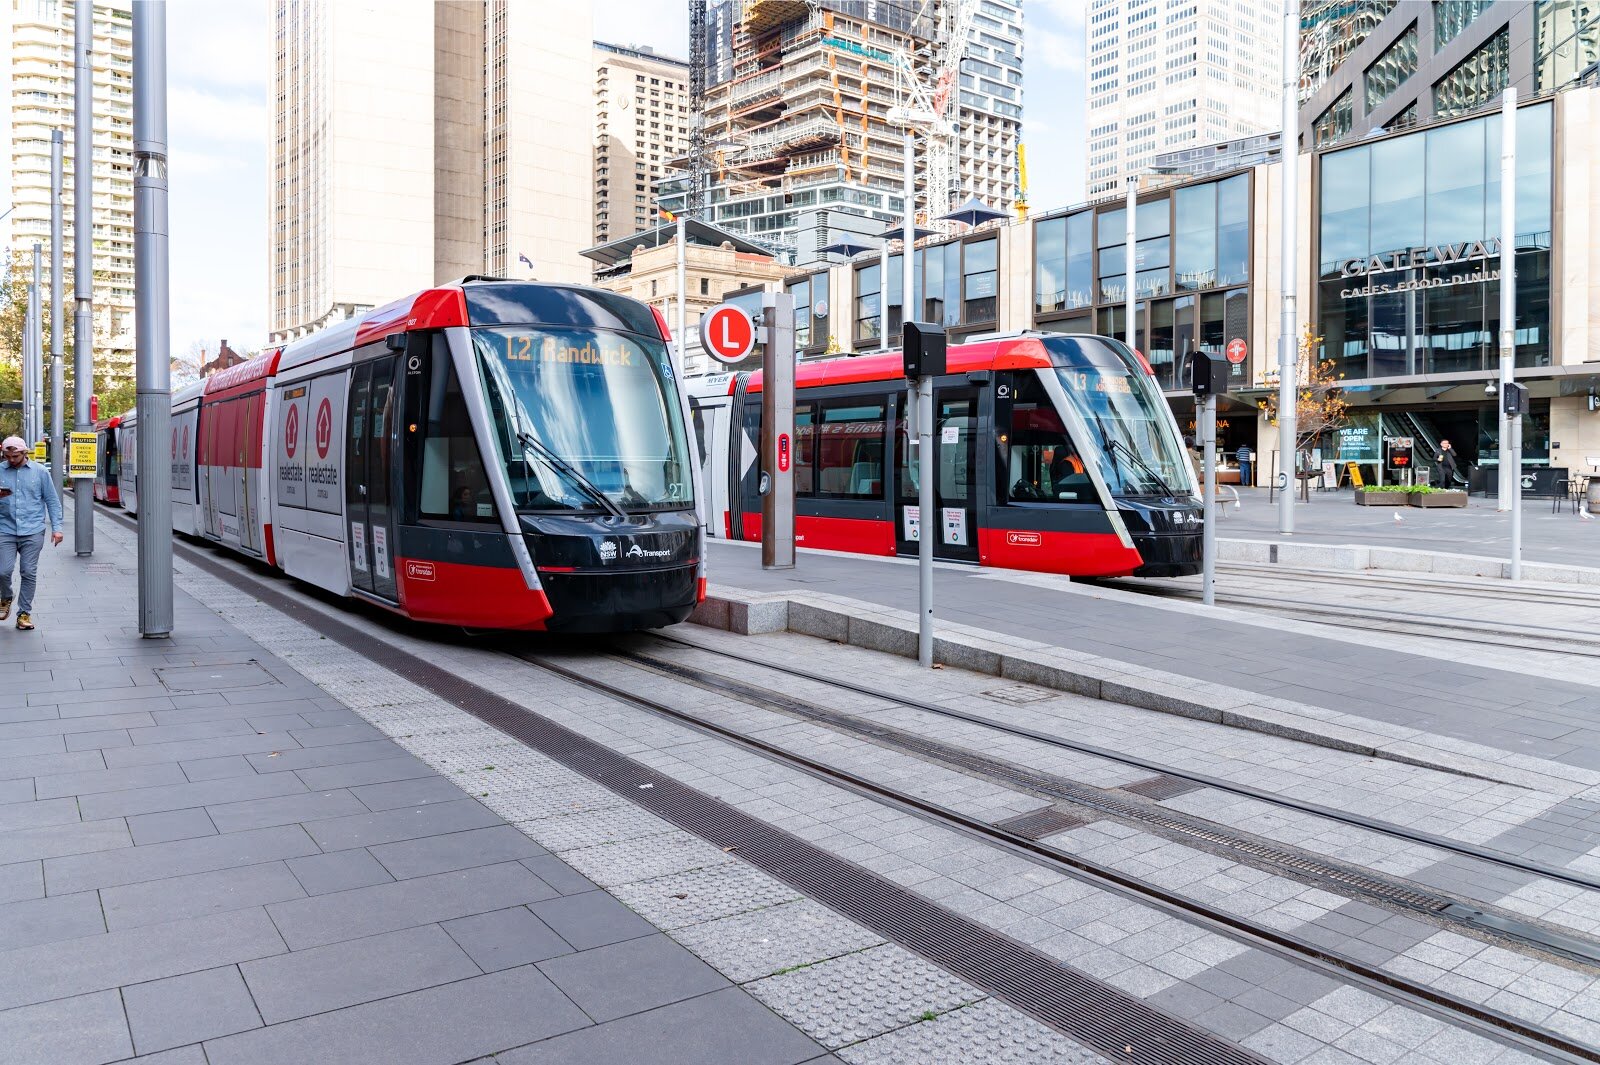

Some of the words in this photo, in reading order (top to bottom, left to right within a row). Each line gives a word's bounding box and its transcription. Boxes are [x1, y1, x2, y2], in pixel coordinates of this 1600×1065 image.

[716, 8, 724, 82] MULTIPLEX
[1340, 284, 1391, 299] CAFES
[1397, 277, 1443, 292] FOOD
[1452, 269, 1519, 285] DININ
[722, 316, 740, 349] L
[506, 335, 531, 361] L2
[543, 337, 632, 366] Randwick
[1073, 373, 1087, 391] L3
[280, 462, 303, 482] realestate
[309, 462, 338, 485] realestate
[669, 483, 684, 499] 27
[642, 549, 671, 558] Transport
